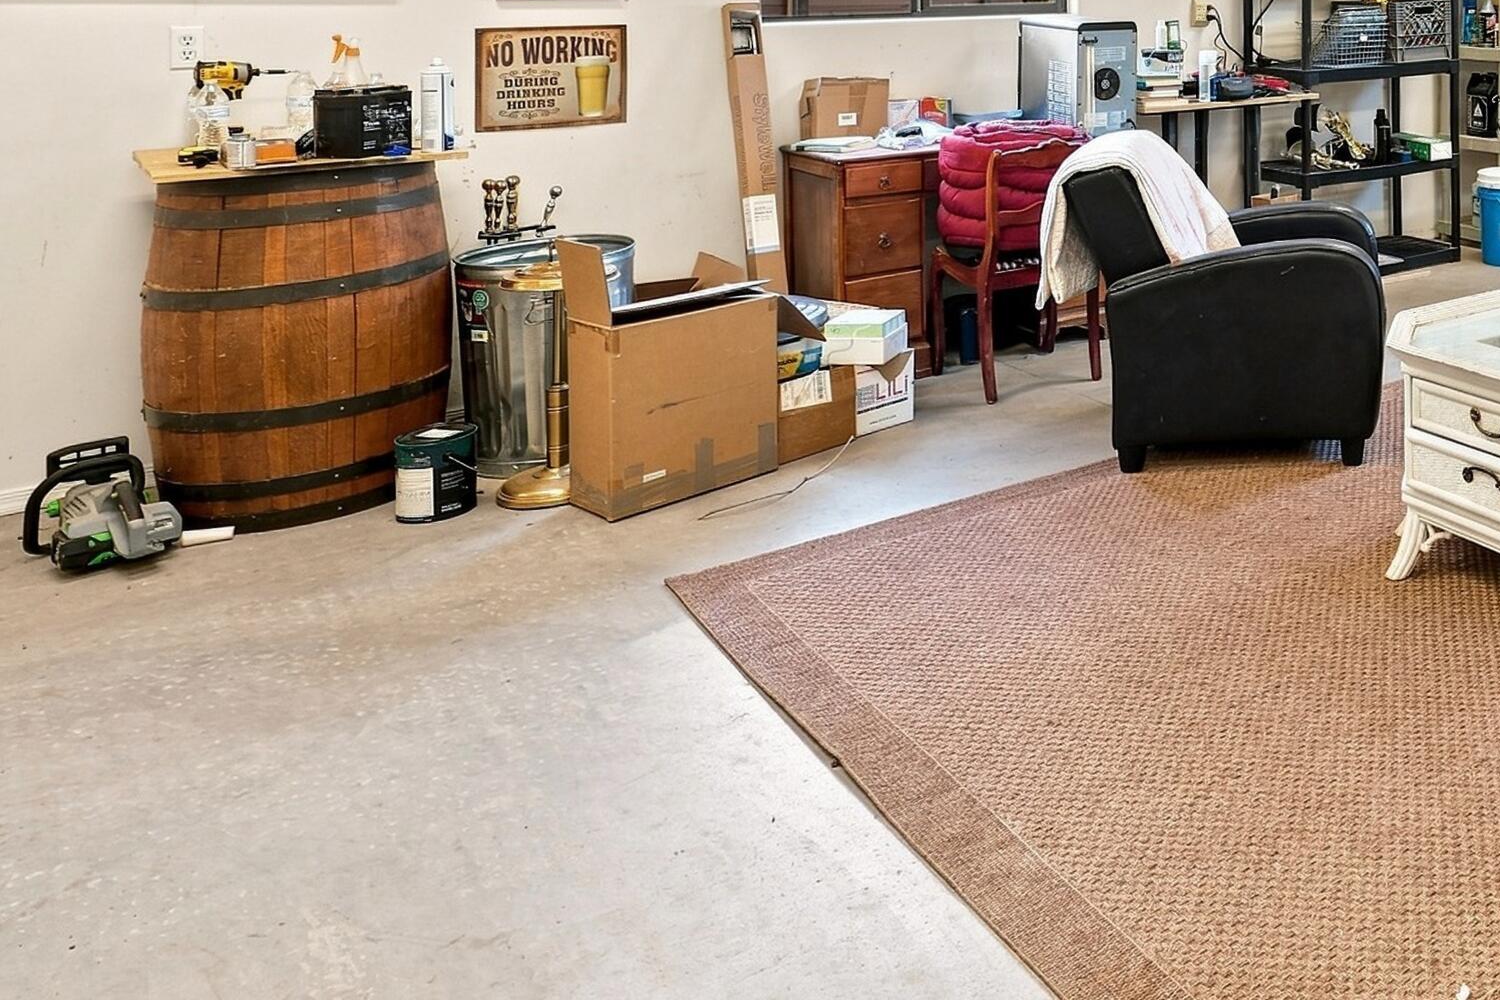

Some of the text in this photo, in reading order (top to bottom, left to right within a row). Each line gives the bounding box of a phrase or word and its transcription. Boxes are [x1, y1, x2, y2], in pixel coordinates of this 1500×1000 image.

[485, 35, 618, 68] NO WORKING
[504, 77, 559, 89] DURING
[496, 87, 566, 100] DRINKING
[507, 98, 556, 111] HOURS
